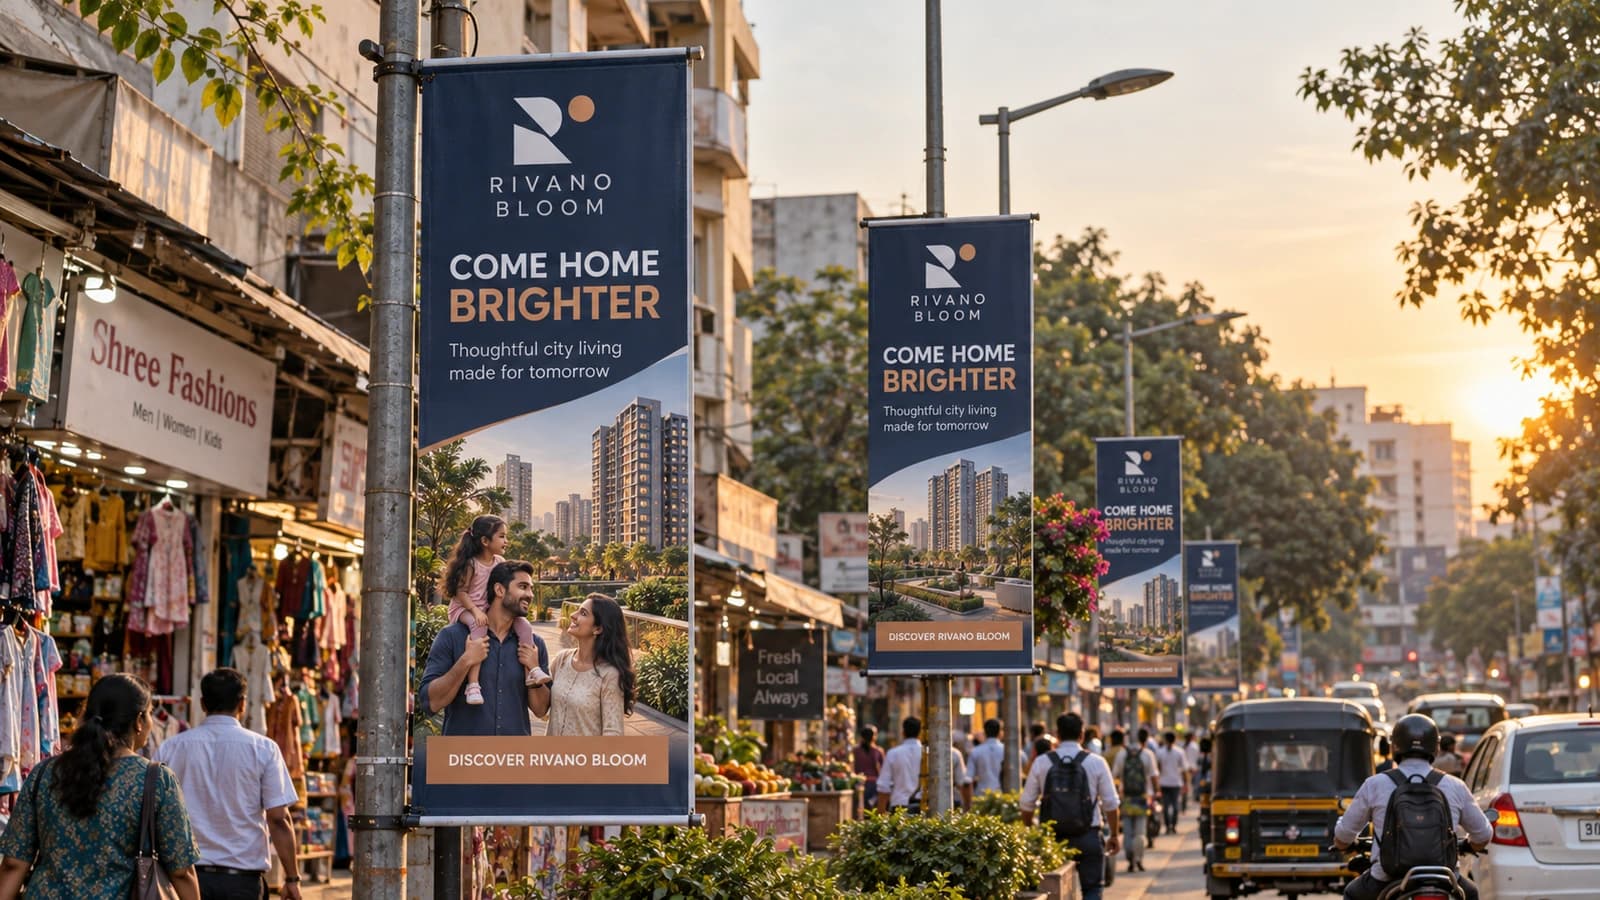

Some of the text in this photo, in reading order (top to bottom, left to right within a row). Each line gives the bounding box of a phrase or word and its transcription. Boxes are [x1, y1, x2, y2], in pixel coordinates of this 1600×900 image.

[489, 173, 612, 193] RIVANO
[496, 198, 604, 217] BLOOM
[449, 250, 660, 280] COME HOME
[449, 285, 661, 323] BRIGHTER
[910, 293, 986, 306] RIVANO
[914, 310, 981, 322] BLOOM
[449, 340, 623, 361] Thoughtful city living
[883, 344, 1016, 364] COME HOME
[90, 318, 257, 429] Shree Fashions
[449, 364, 610, 381] made for tomorrow
[883, 367, 1016, 393] BRIGHTER
[883, 405, 997, 418] Thoughtful city living
[132, 401, 154, 425] Men
[162, 413, 197, 441] Women
[204, 430, 223, 450] Kids
[883, 420, 990, 432] made for tomorrow
[1117, 477, 1158, 485] RIVANO
[1120, 485, 1155, 494] BLOOM
[1104, 504, 1174, 516] COME HOME
[1104, 516, 1175, 531] BRIGHTER
[888, 631, 1010, 641] DISCOVER RIVANO BLOOM
[758, 649, 801, 666] Fresh
[757, 669, 799, 686] Local
[753, 688, 809, 707] Always
[448, 753, 647, 767] DISCOVER RIVANO BLOOM
